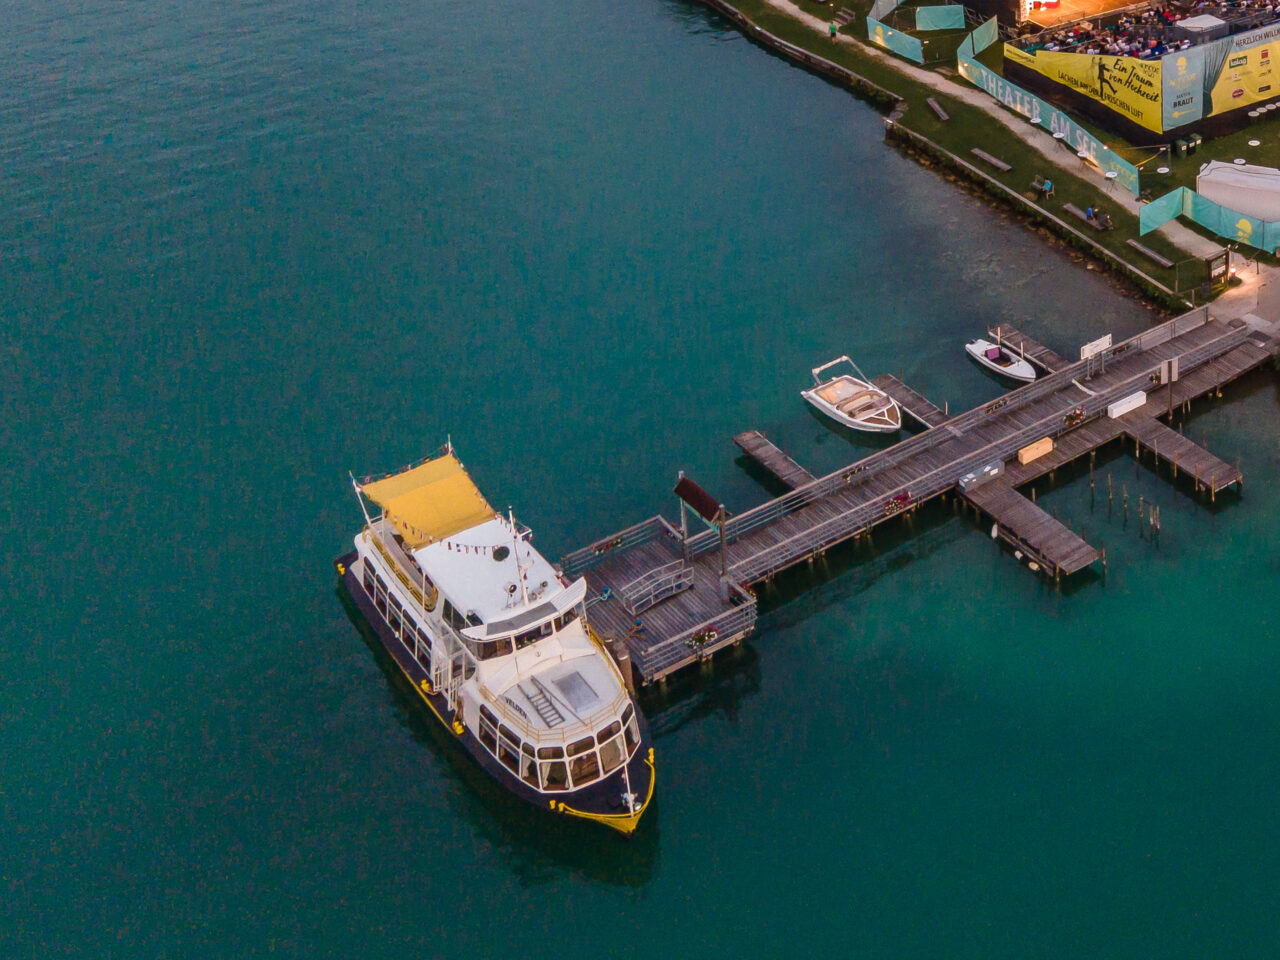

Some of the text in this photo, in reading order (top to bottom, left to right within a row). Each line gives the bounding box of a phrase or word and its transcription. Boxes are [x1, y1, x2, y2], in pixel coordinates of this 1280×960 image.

[1235, 34, 1263, 47] HERZLICH
[1109, 73, 1123, 85] von
[1123, 78, 1160, 103] Hochzeit
[1113, 58, 1128, 74] Ein
[1127, 65, 1154, 88] Traum
[1058, 70, 1079, 88] LACHEN
[1130, 104, 1144, 121] LUFT
[1173, 96, 1194, 109] BRAUT
[981, 68, 1041, 120] THEATER
[1050, 111, 1071, 144] AM
[1075, 129, 1097, 161] SEE
[505, 696, 527, 719] VELDEN
